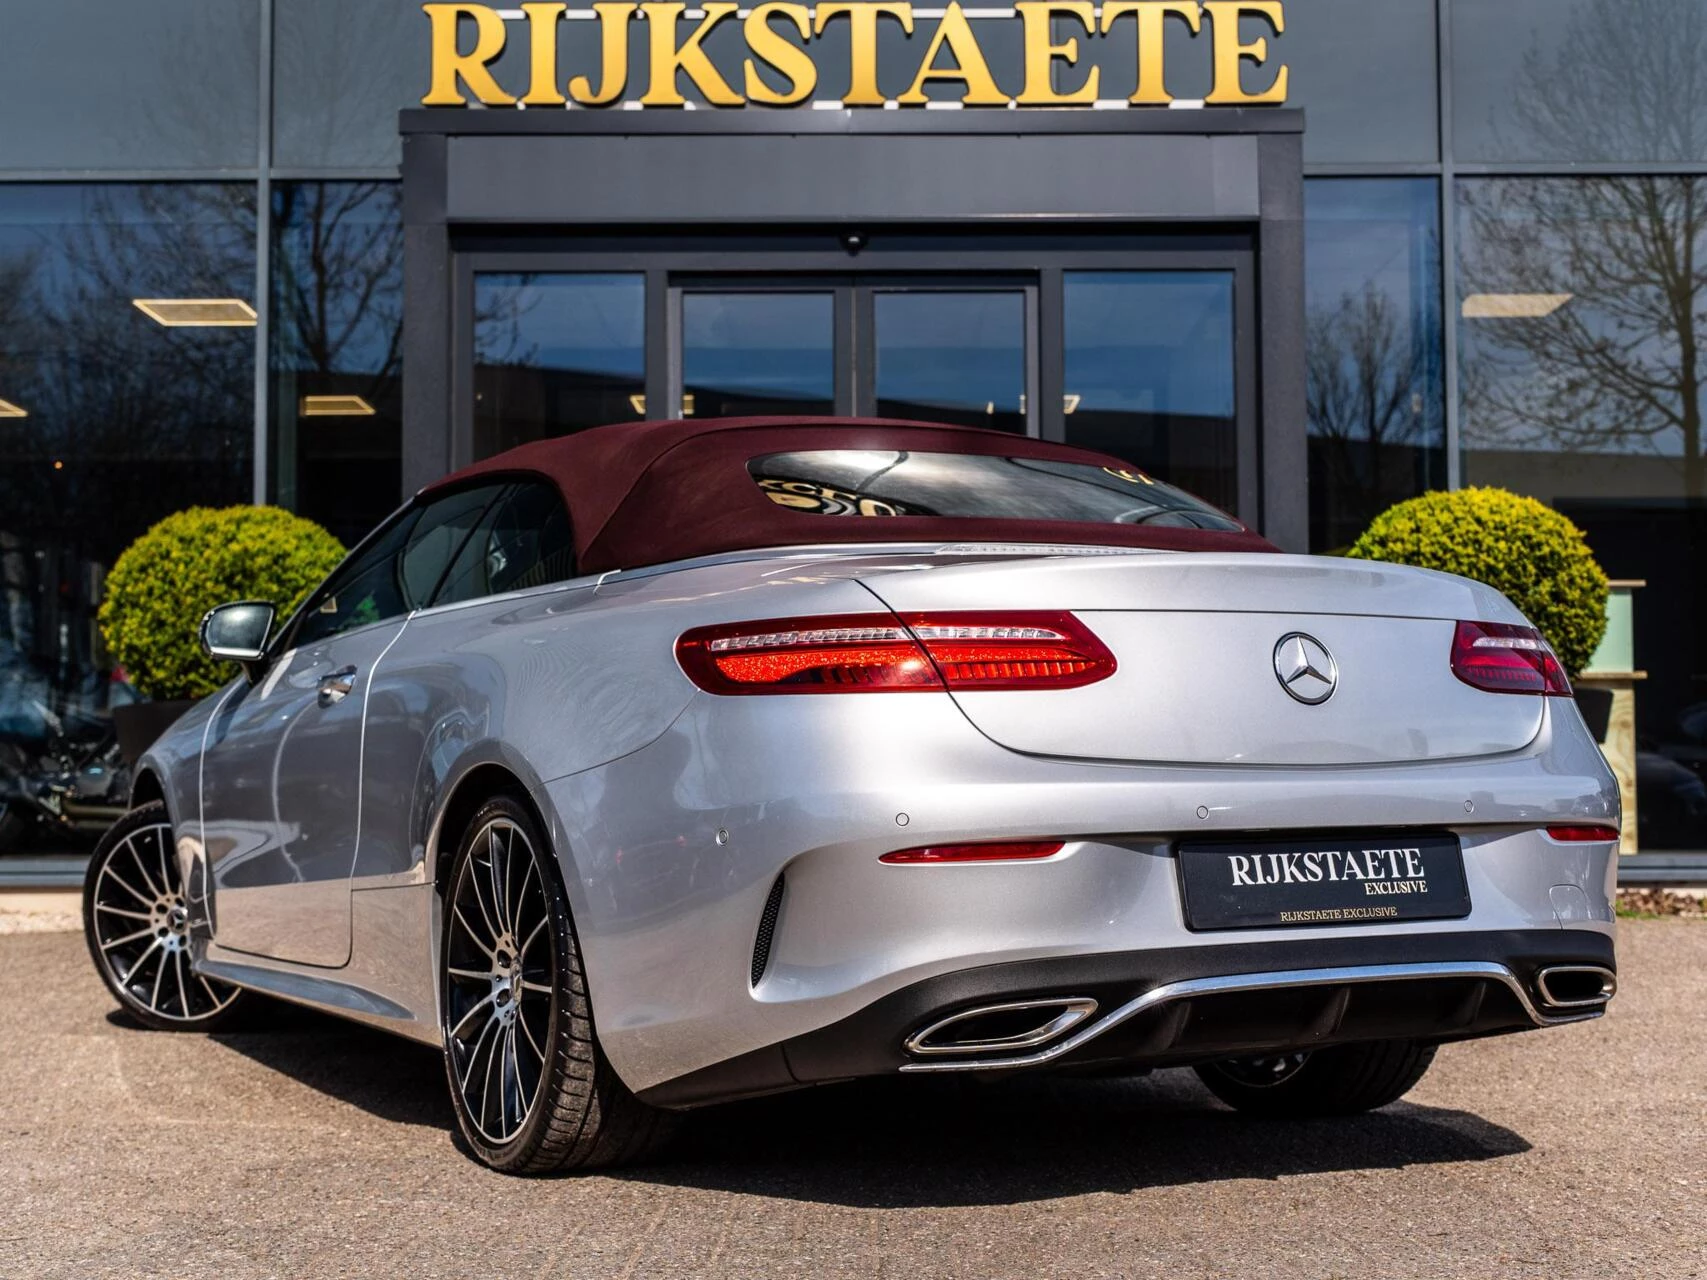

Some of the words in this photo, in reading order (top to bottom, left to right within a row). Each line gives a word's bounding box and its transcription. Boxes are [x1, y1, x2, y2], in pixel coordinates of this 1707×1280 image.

[422, 0, 1288, 106] RIJKSTAETE
[1228, 848, 1425, 886] RIJKSTAETE
[1365, 880, 1428, 895] EXCLUSIVE
[1280, 909, 1342, 922] RIJKSTAETE
[1343, 906, 1398, 919] EXCLUSIVE
